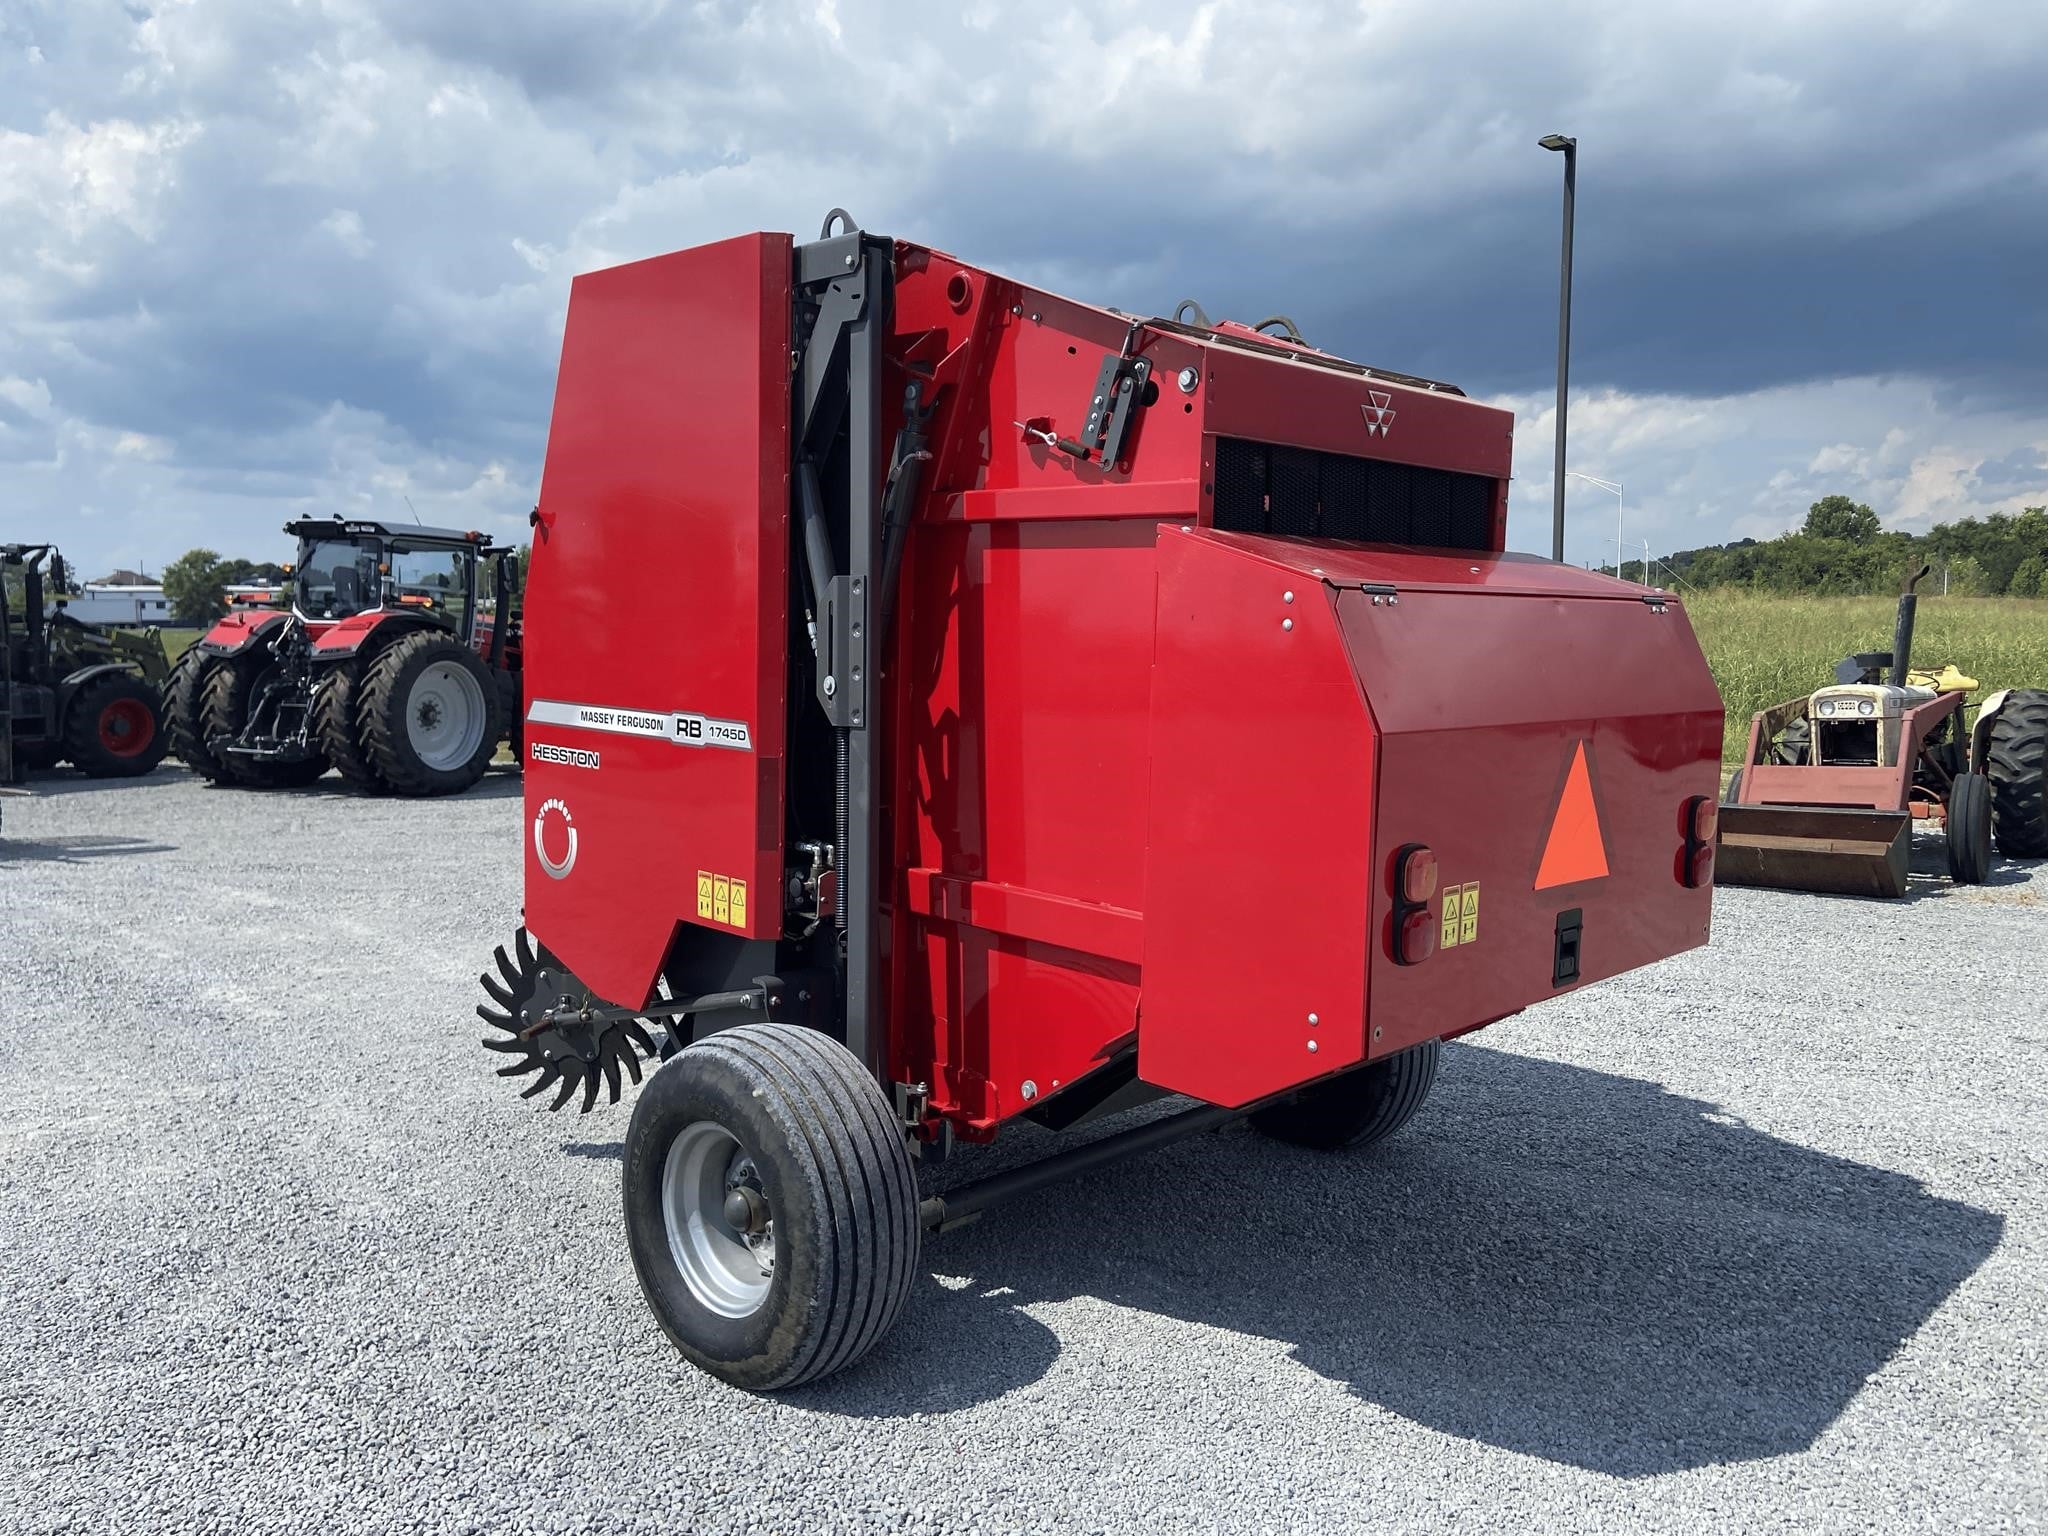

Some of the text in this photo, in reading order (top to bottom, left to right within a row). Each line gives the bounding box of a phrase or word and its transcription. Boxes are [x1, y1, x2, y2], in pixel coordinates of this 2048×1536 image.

[580, 711, 746, 741] MASSEY FERGUSON RB 1745D
[532, 744, 599, 768] HESSTON
